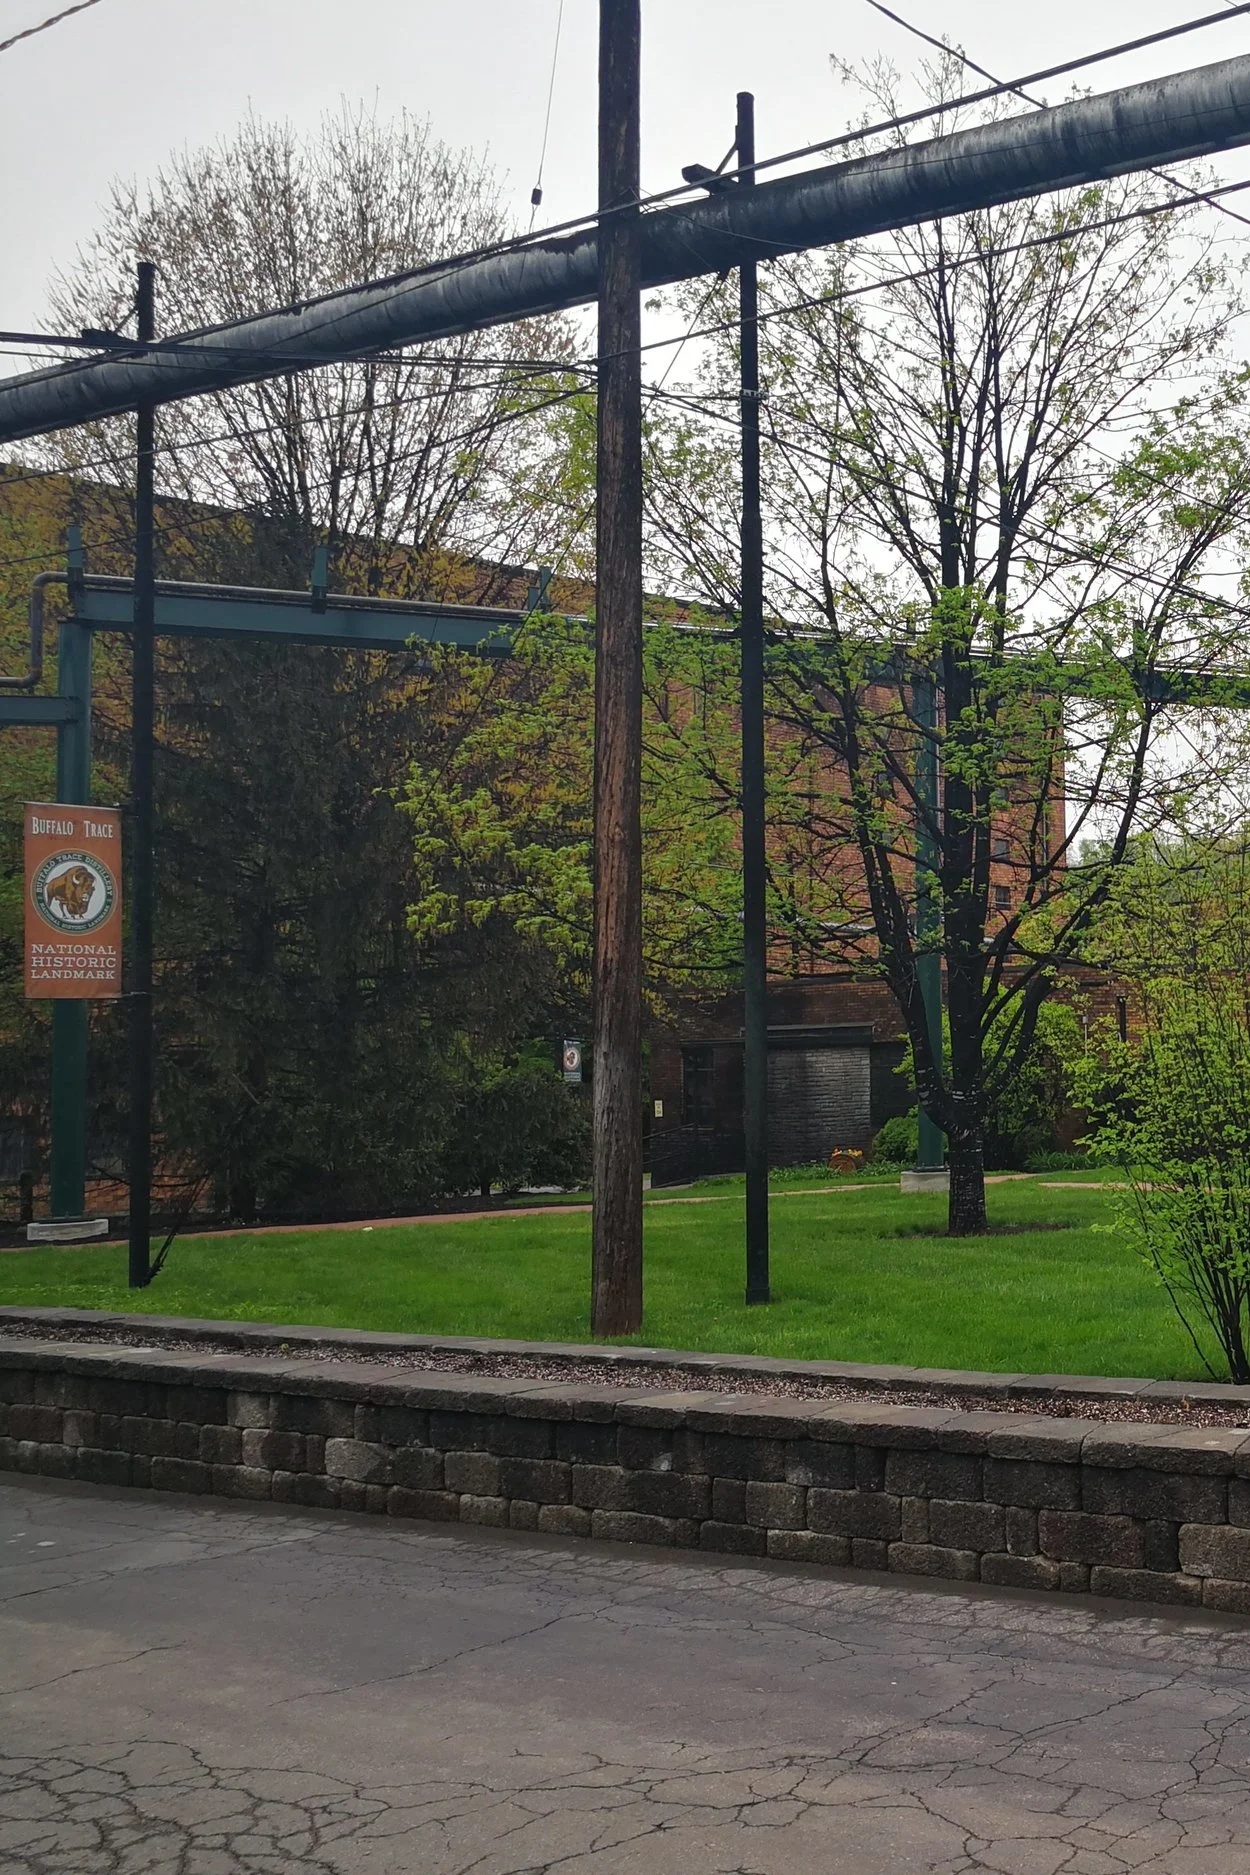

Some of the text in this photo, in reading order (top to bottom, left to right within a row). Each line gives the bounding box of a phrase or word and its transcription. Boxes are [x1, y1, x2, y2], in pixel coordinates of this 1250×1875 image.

[32, 817, 113, 838] BUFFALO TRACE
[37, 854, 113, 895] BUFFALO TRACE DISTILLERY
[32, 944, 116, 954] NATIONAL
[32, 957, 116, 968] HISTORIC
[32, 970, 116, 979] LANDMARK
